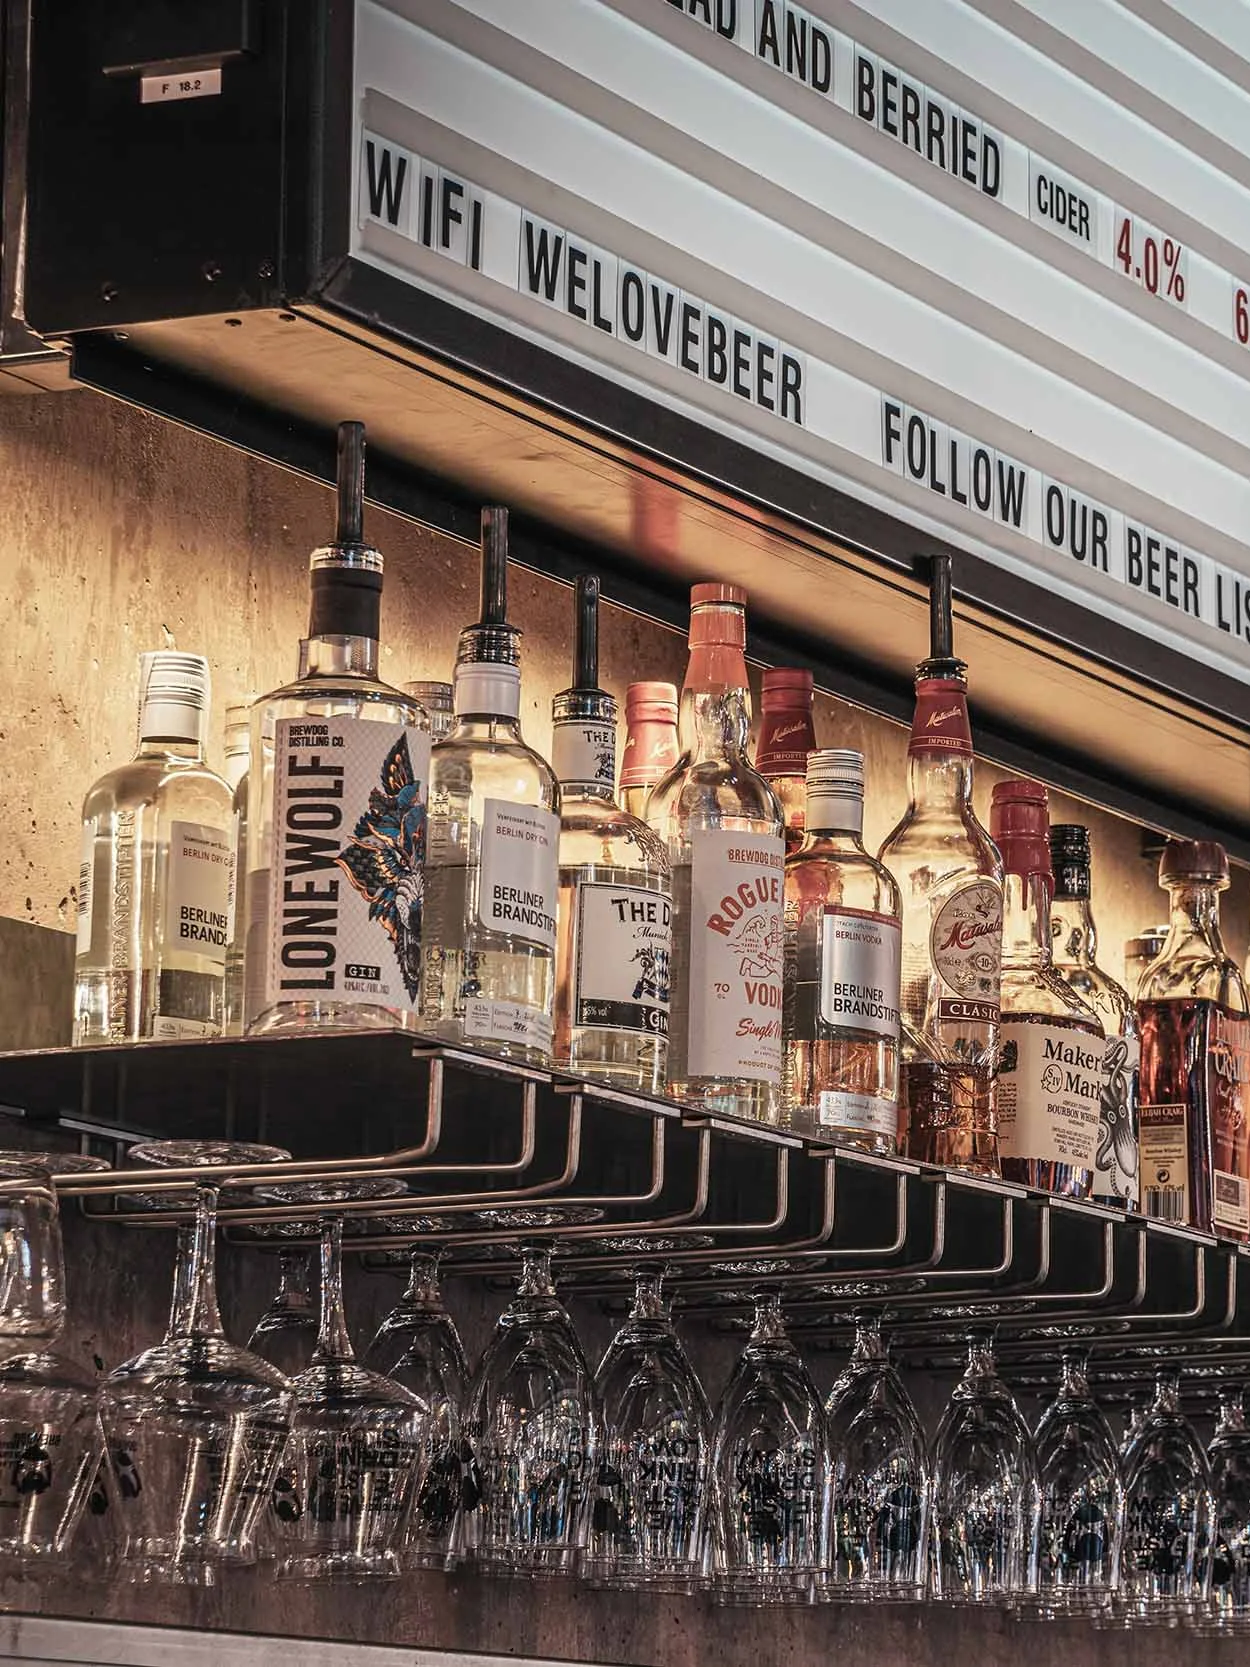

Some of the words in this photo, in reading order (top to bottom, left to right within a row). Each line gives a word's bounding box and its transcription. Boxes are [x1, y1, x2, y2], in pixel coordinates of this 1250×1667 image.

[162, 82, 170, 94] F
[179, 79, 202, 92] 18.2
[758, 0, 832, 94] AND
[857, 55, 1001, 198] BERRIED
[1036, 174, 1090, 241] CIDER
[1116, 218, 1186, 302] 4.0%
[366, 140, 483, 271] WIFI
[525, 220, 803, 425] WELOVEBEER
[884, 401, 1026, 528] FOLLOW
[1046, 485, 1109, 573] OUR
[1127, 528, 1200, 618] BEER
[289, 725, 329, 736] BREWDOG
[583, 730, 609, 743] THE
[288, 736, 330, 748] DISTILLING
[495, 825, 524, 839] BERLIN
[525, 829, 539, 842] DRY
[183, 847, 210, 861] BERLIN
[728, 849, 769, 865] BREWDOG
[280, 755, 345, 990] LONEWOLF
[493, 885, 544, 909] BERLINER
[611, 897, 657, 923] THE
[706, 876, 779, 937] ROGUE
[835, 930, 861, 942] BERLIN
[348, 966, 378, 979] GIN
[714, 983, 730, 993] 70
[834, 983, 884, 1002] BERLINER
[650, 1011, 669, 1032] GIN
[735, 1018, 774, 1041] Single
[1064, 1071, 1103, 1100] Mark
[1047, 1104, 1079, 1119] BOURBON
